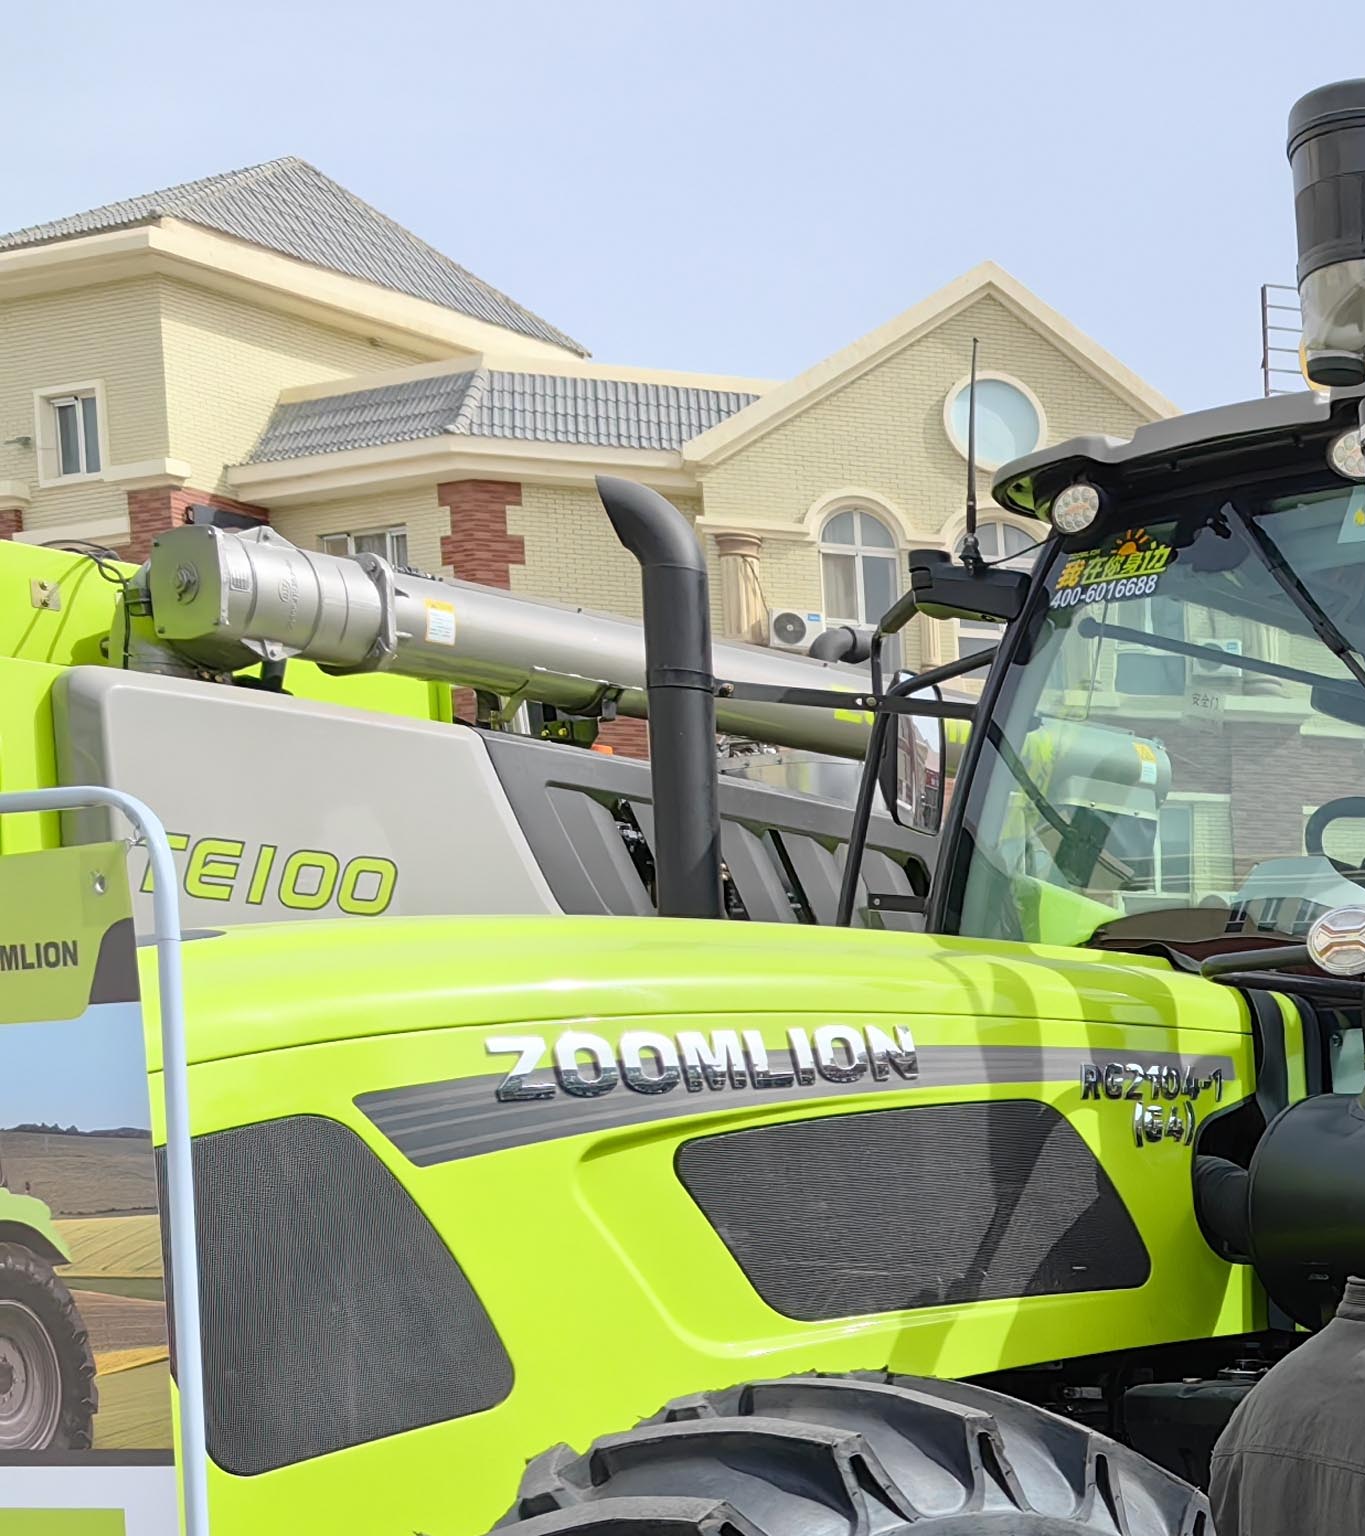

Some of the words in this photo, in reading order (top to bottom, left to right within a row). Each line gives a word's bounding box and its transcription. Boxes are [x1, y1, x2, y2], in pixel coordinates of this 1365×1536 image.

[1050, 574, 1158, 609] 400-6016688
[484, 1024, 919, 1103] ZOOMLION
[1080, 1062, 1223, 1103] RG2104-1
